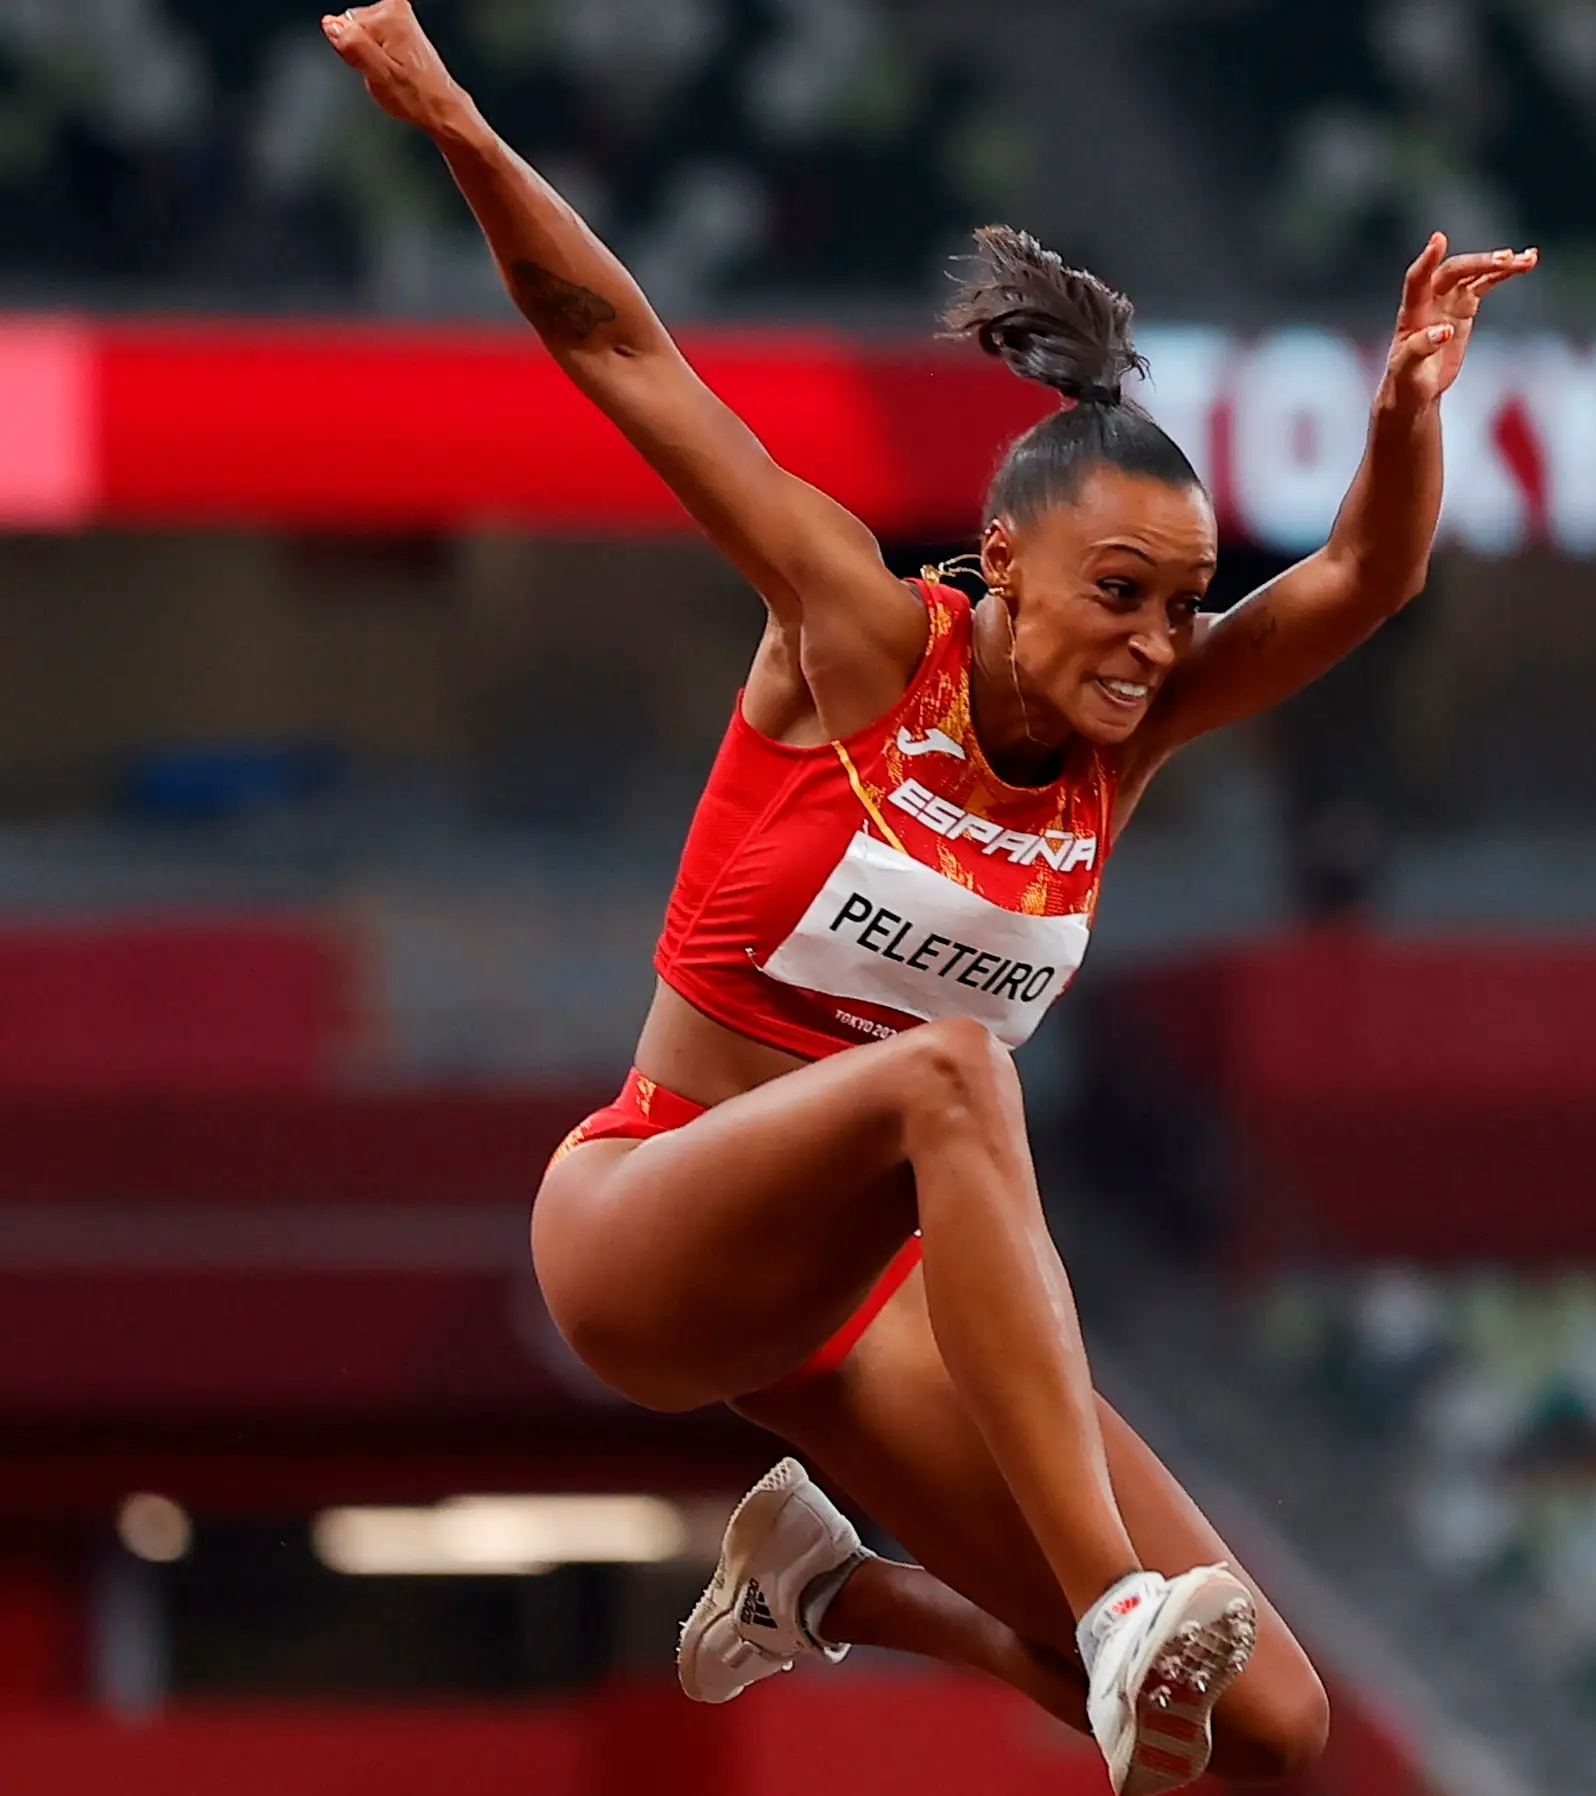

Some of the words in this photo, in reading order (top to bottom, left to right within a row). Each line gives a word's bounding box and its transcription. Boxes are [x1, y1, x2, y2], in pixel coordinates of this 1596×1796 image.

[887, 777, 1097, 872] ESPAÑA
[829, 892, 1055, 1003] PELETEIRO
[834, 1008, 875, 1034] TOKYO
[871, 1023, 898, 1041] 202
